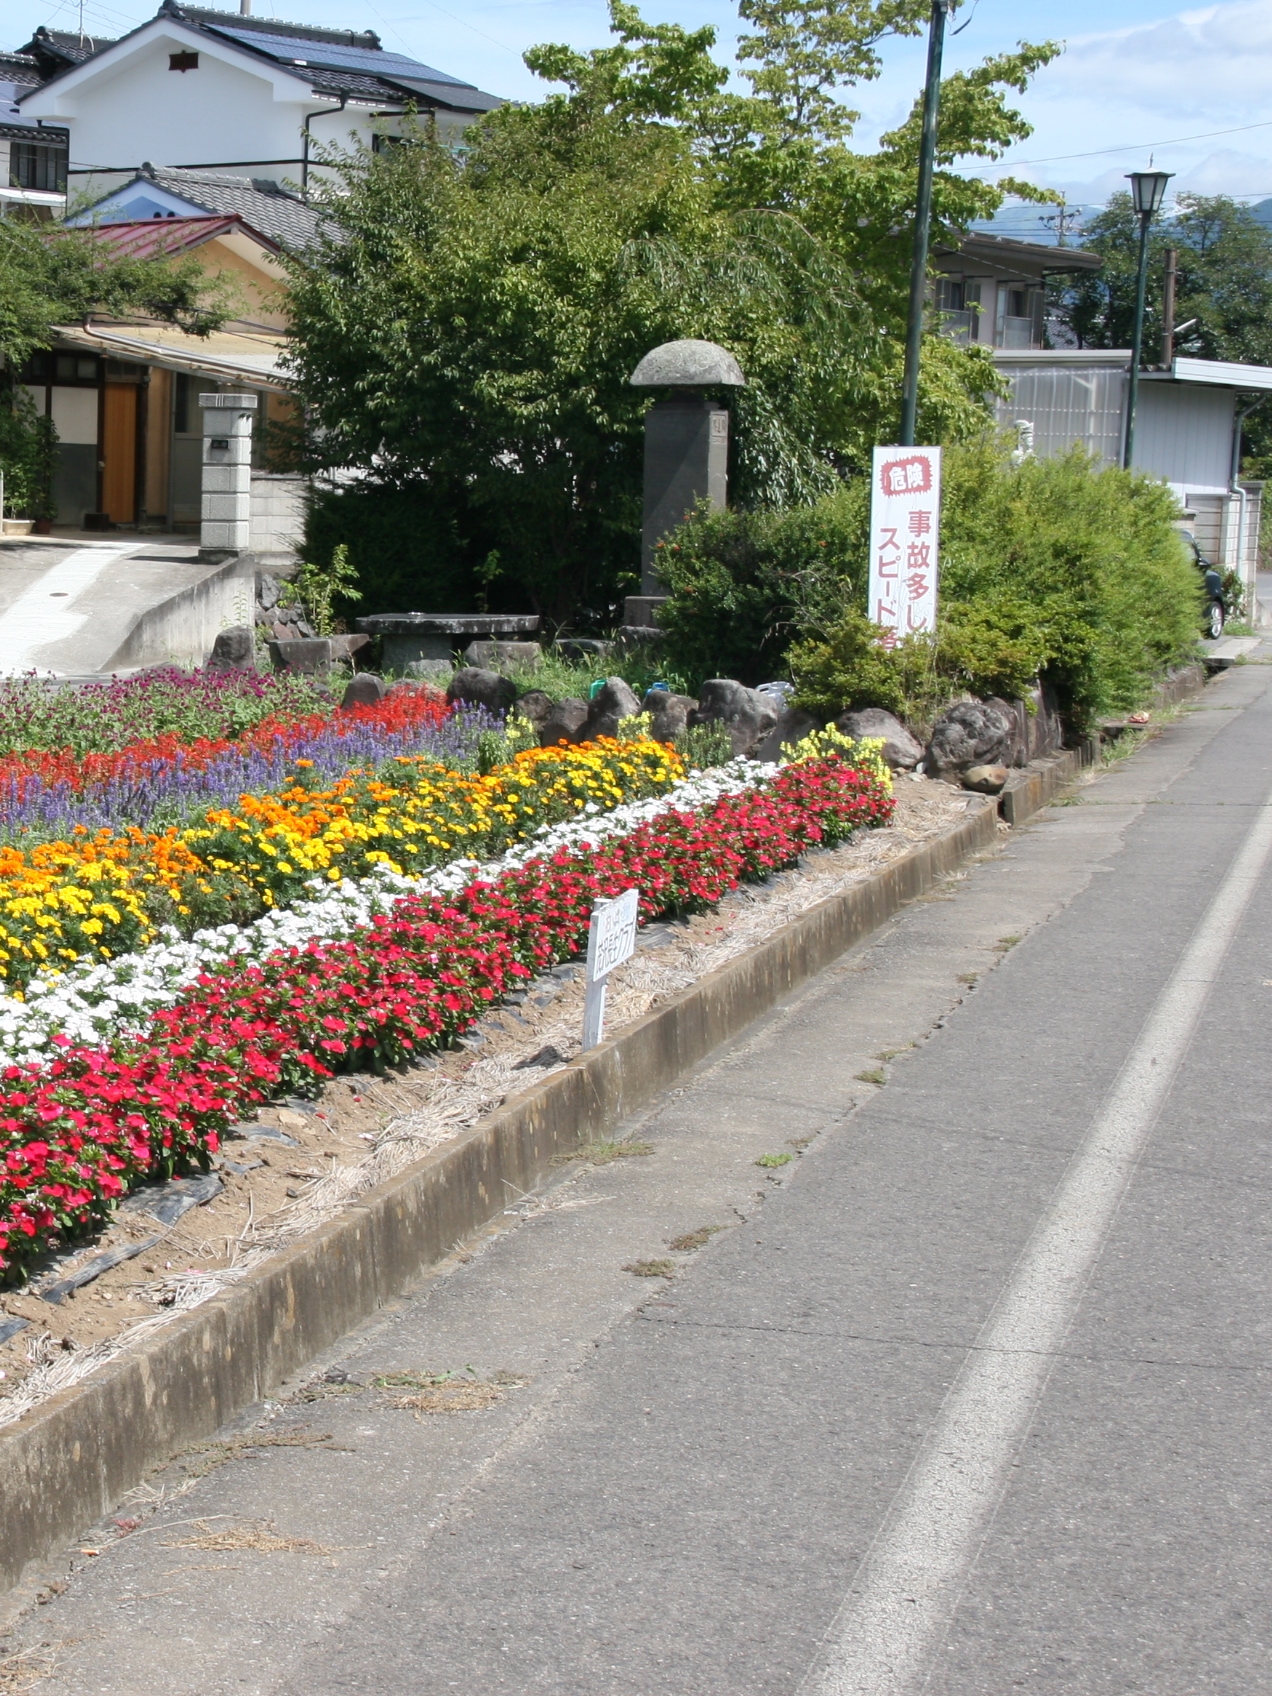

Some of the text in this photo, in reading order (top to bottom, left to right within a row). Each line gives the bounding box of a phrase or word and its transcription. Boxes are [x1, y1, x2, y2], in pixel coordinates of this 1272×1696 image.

[889, 462, 924, 491] 危険
[906, 510, 932, 631] 事故多し
